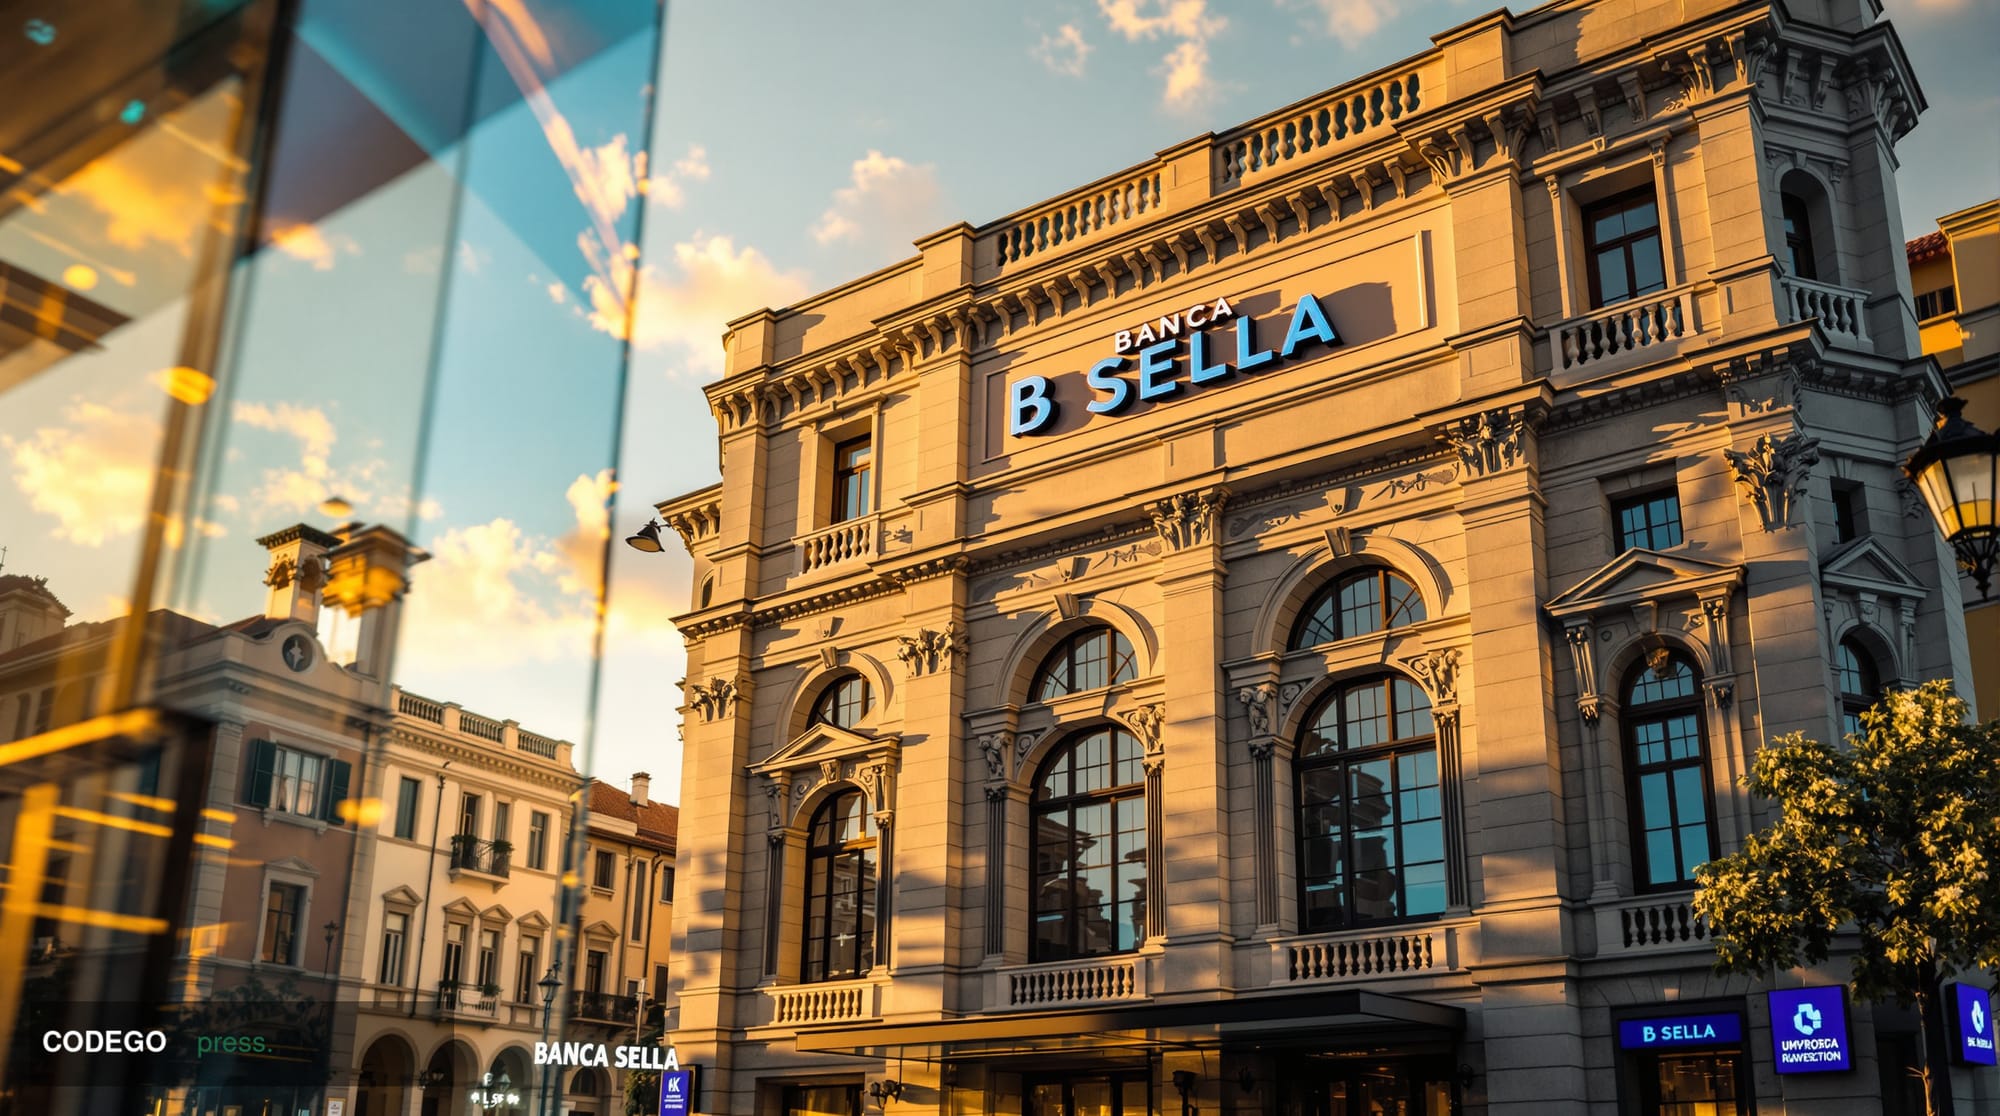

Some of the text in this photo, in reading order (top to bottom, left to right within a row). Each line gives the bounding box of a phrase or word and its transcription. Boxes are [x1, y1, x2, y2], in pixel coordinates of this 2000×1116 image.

[1114, 297, 1233, 354] BANCA
[1010, 293, 1337, 437] B SELLA
[1643, 1024, 1716, 1042] B SELLA
[534, 1041, 680, 1071] BANCA SELLA
